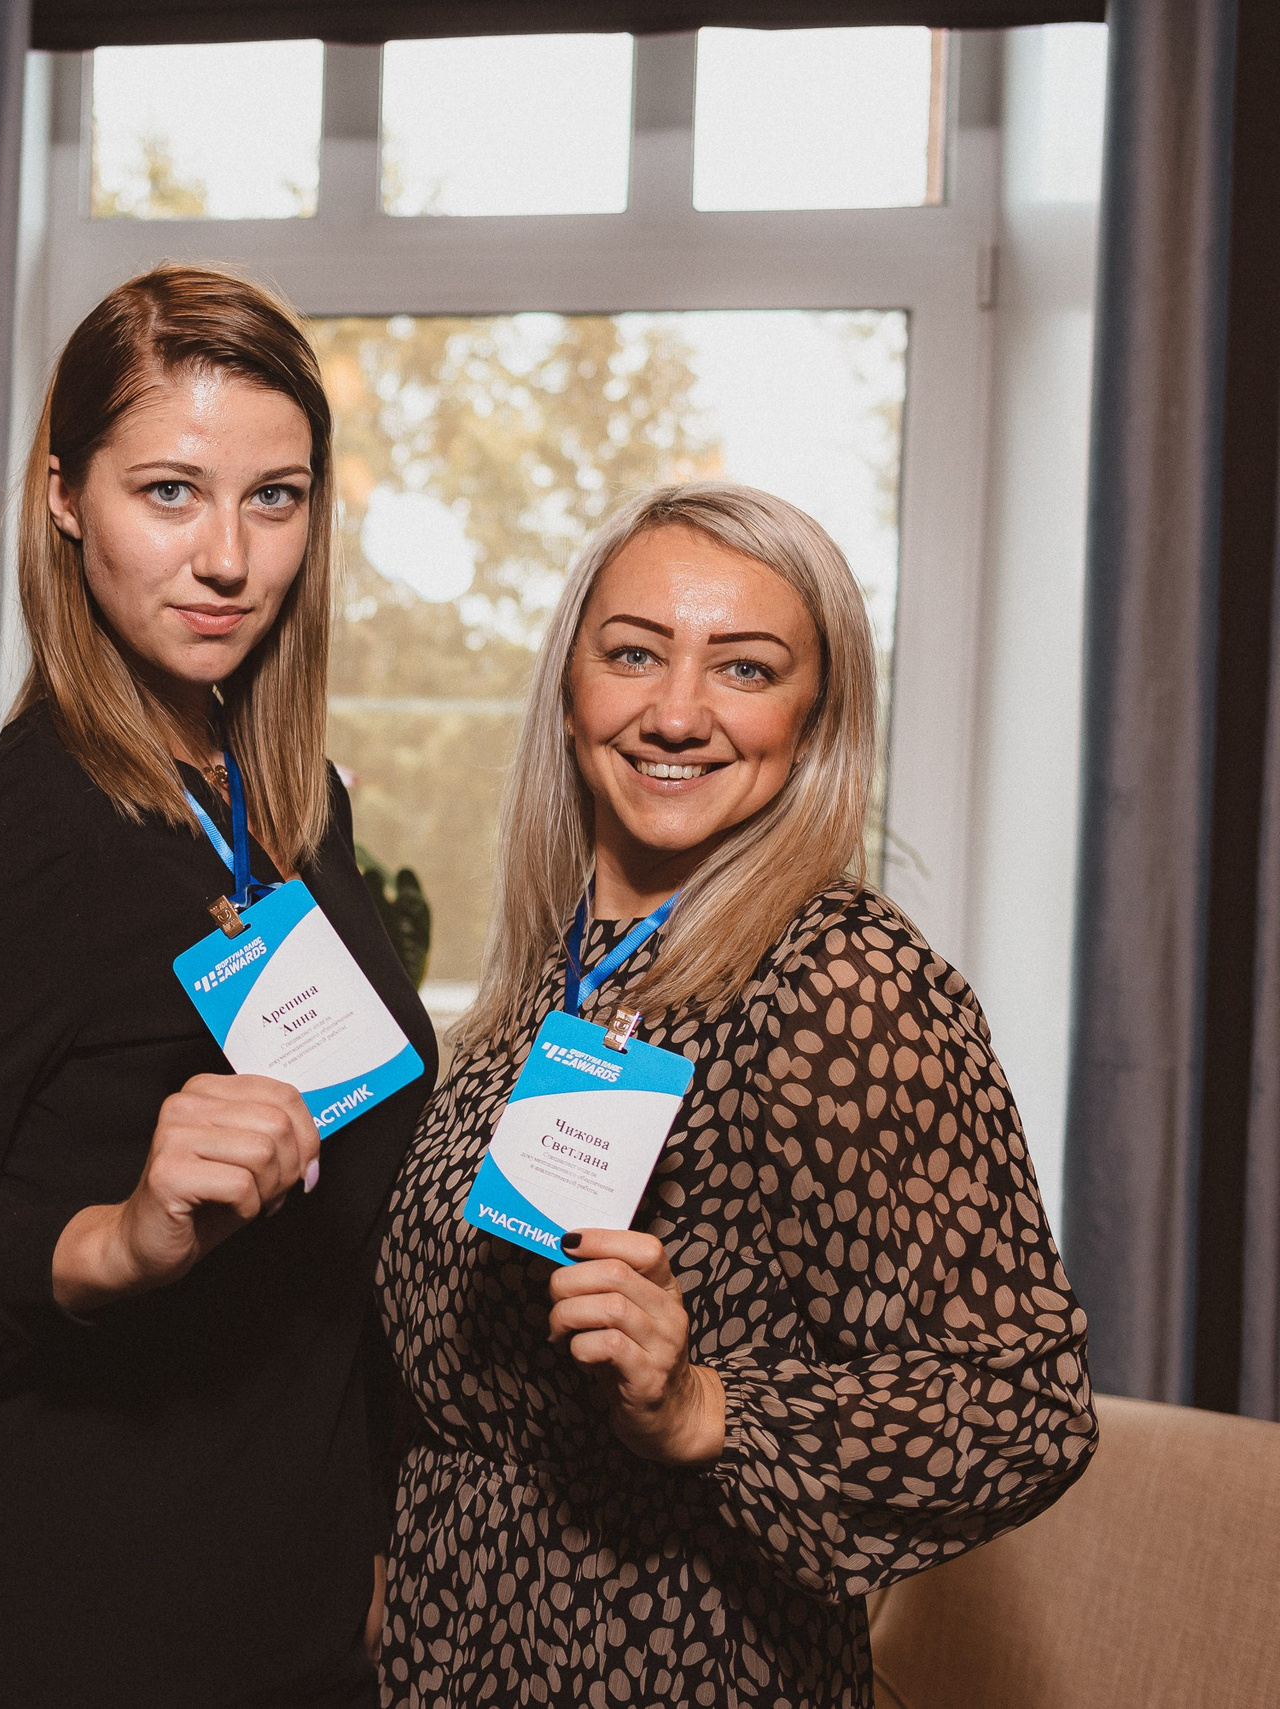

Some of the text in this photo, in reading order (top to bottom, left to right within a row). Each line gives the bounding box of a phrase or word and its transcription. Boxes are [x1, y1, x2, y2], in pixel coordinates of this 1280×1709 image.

[214, 948, 244, 971] ФОРТУНА
[224, 941, 268, 979] AWARDS
[261, 984, 319, 1027] Арепина
[283, 1008, 318, 1037] Анна
[568, 1057, 620, 1083] AWARDS
[312, 1083, 374, 1129] АСТНИК
[541, 1134, 609, 1171] Светлана
[557, 1117, 610, 1151] Чижова
[478, 1203, 561, 1250] УЧАСТНИК
